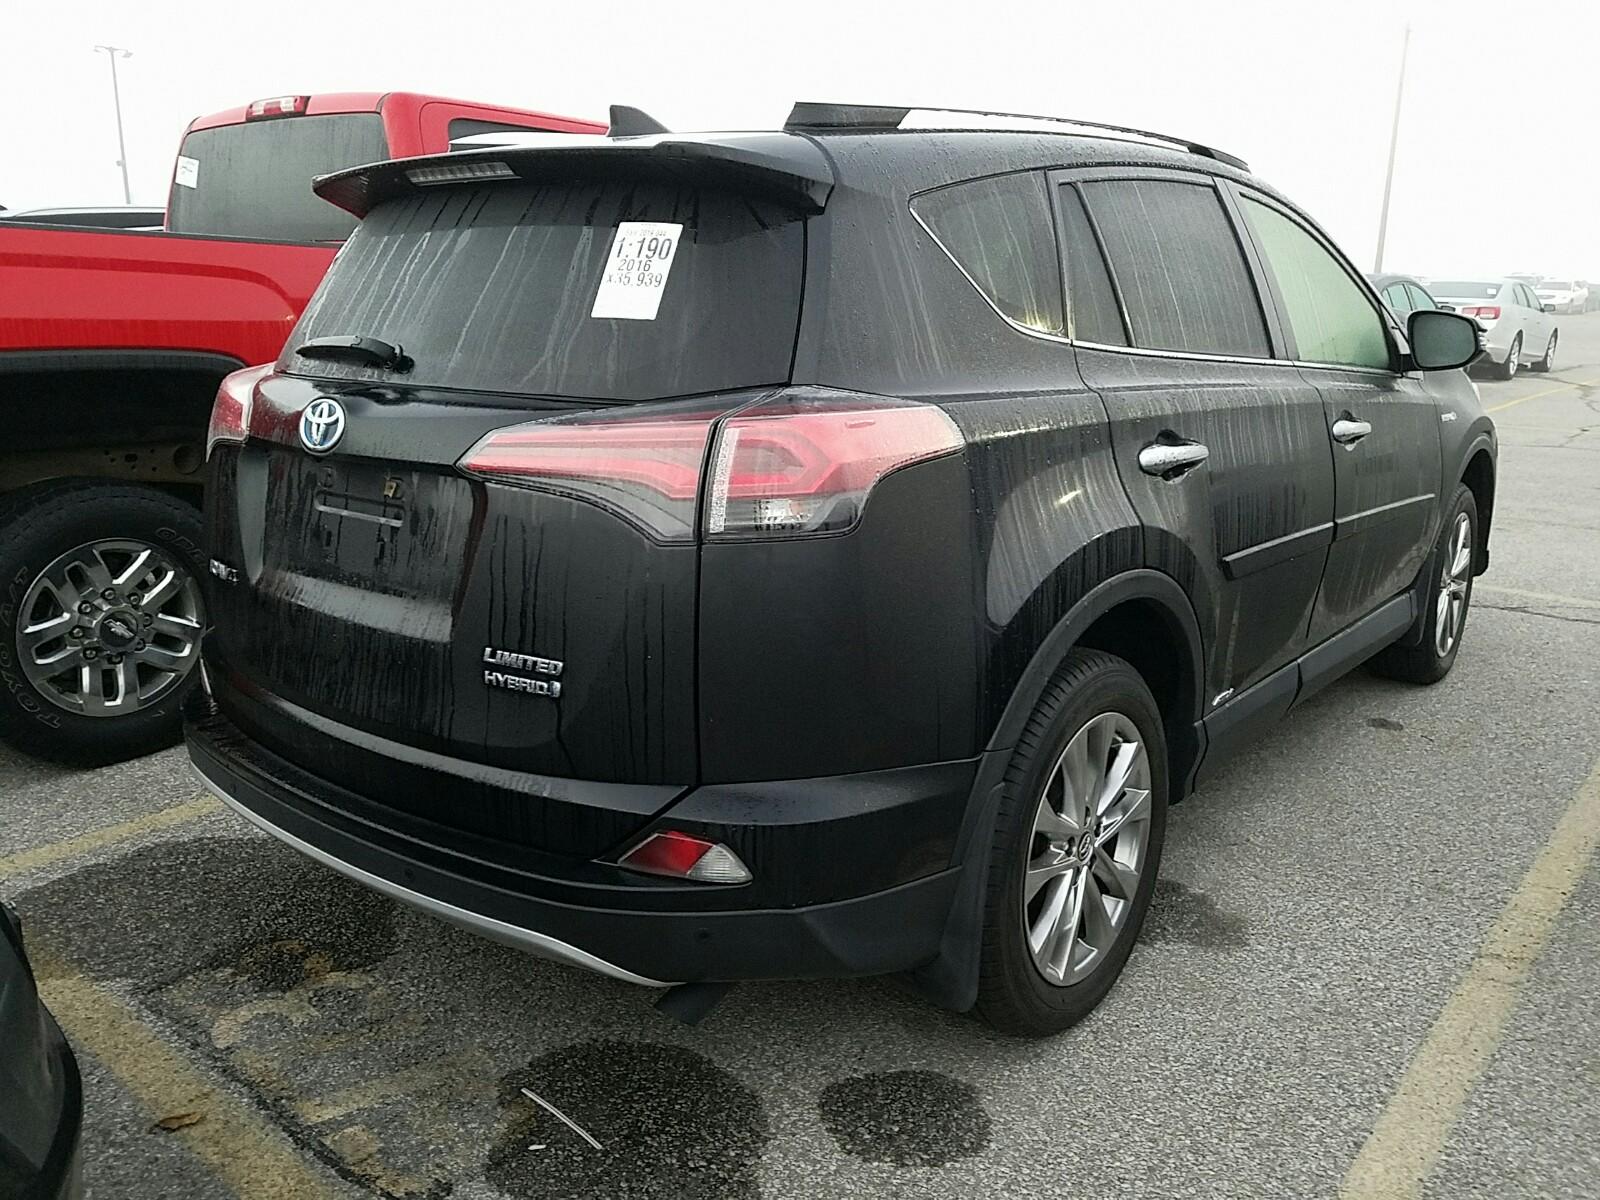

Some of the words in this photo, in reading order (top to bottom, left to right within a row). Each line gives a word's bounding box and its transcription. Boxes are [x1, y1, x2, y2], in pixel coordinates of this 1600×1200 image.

[617, 237, 672, 260] 1:190
[617, 259, 653, 272] 2016
[483, 647, 564, 676] LIMITED
[484, 670, 549, 695] HYBRID
